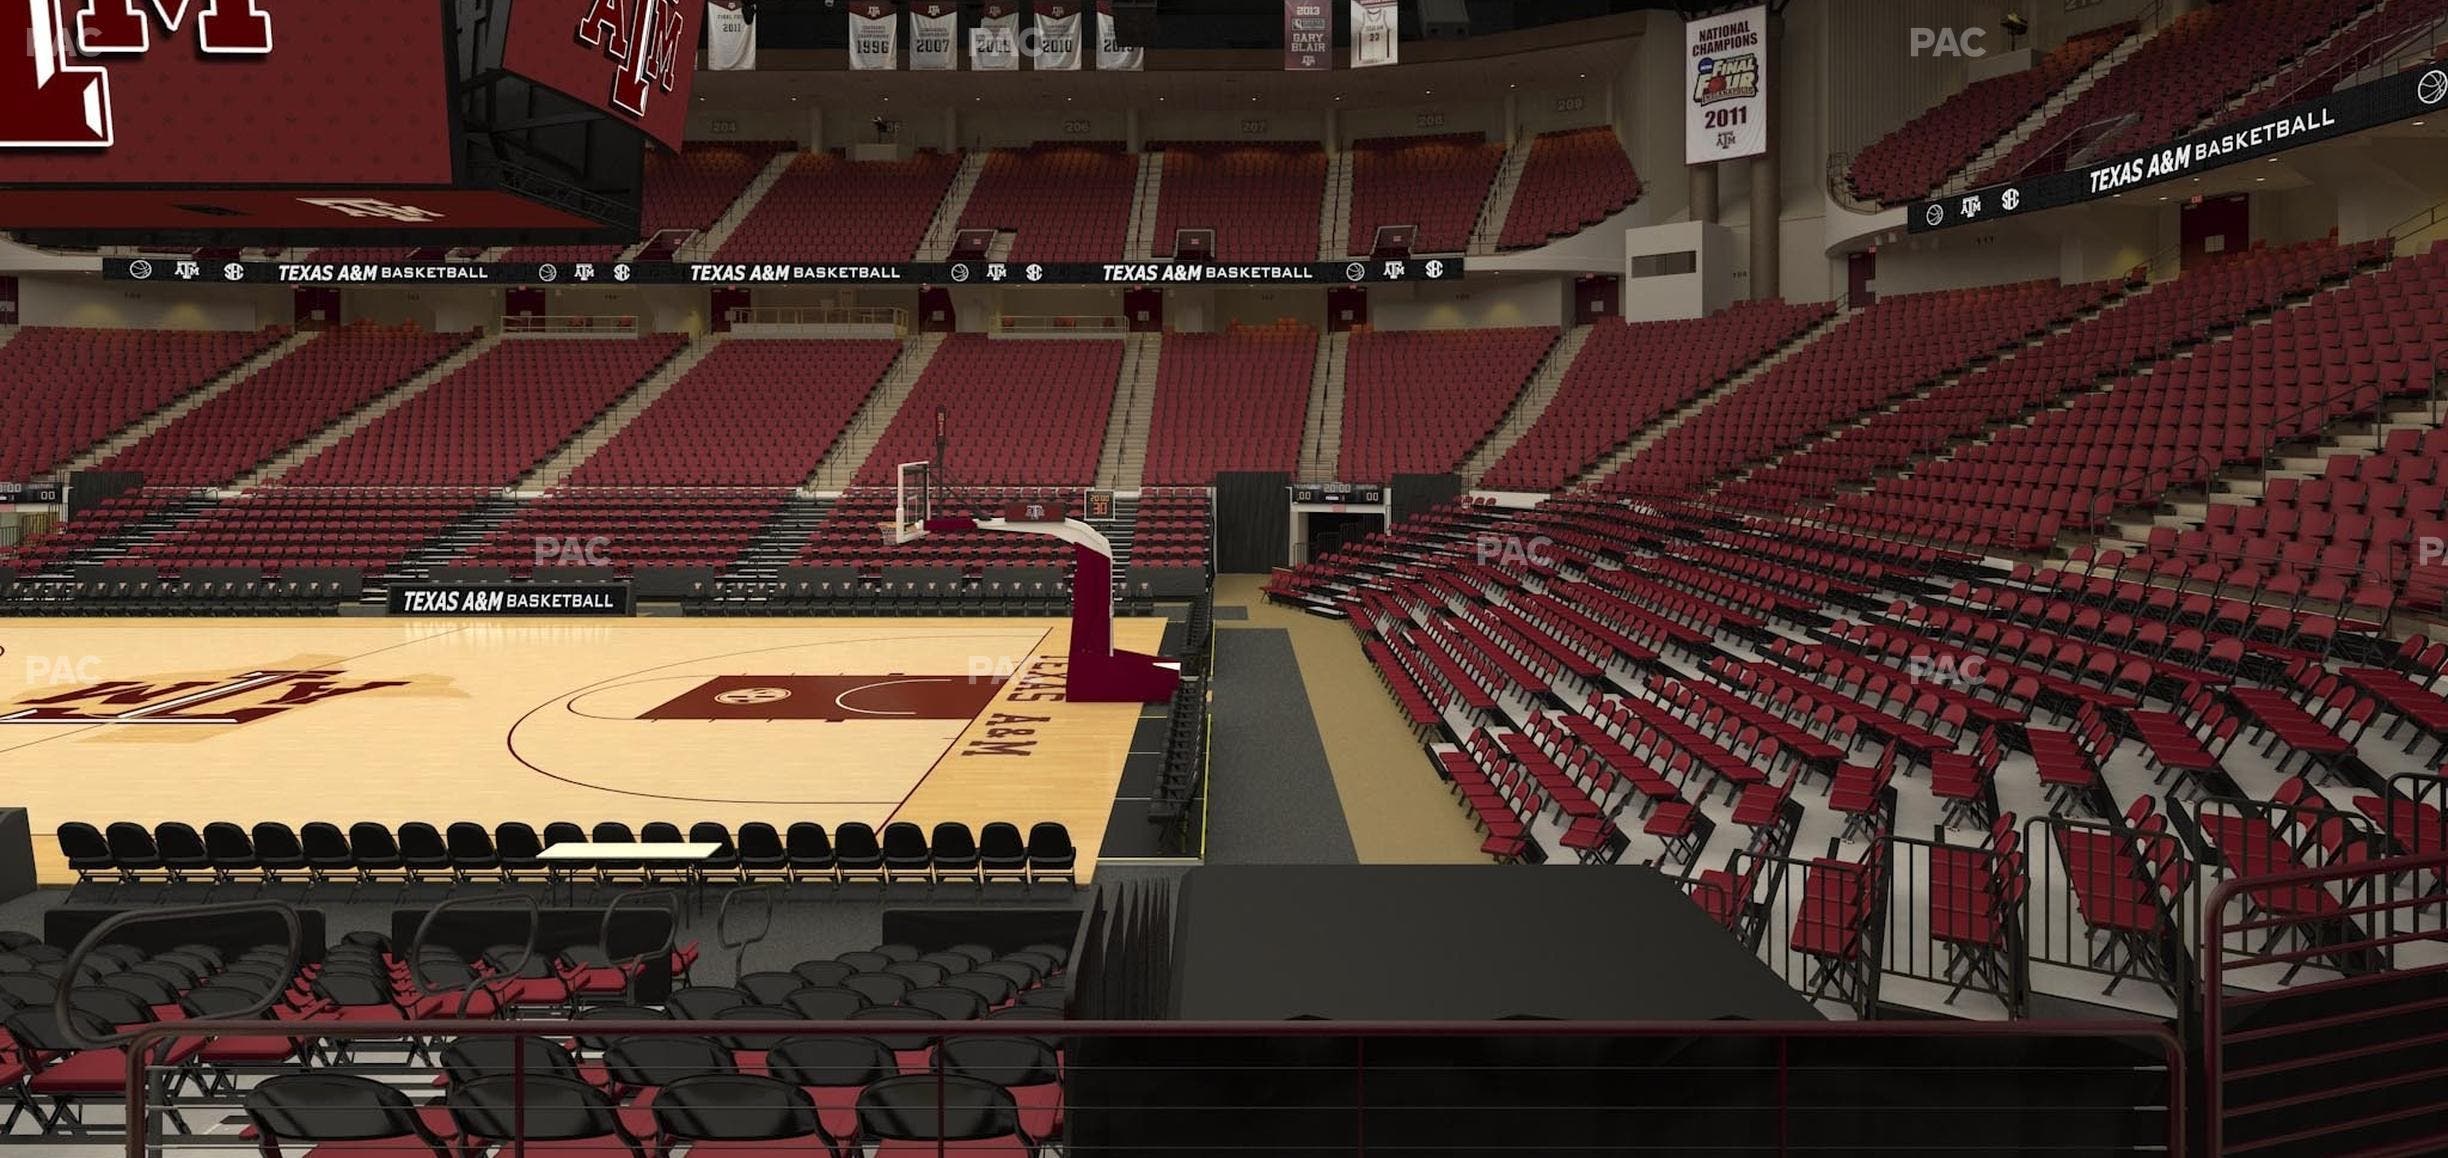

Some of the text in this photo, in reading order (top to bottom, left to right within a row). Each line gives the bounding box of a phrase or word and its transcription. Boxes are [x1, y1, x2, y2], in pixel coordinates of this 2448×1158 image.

[1296, 6, 1320, 16] 2013
[1293, 33, 1324, 43] GARY
[1699, 20, 1750, 42] NATIONAL
[857, 39, 890, 54] 1996
[916, 38, 949, 53] 2007
[1042, 39, 1073, 53] 2010
[1291, 42, 1326, 53] BLAIR
[1692, 32, 1758, 57] CHAMPIONS
[1713, 58, 1755, 77] FINAL
[1705, 105, 1747, 129] 2011
[2090, 108, 2336, 193] TEXAS A&M BASKETBALL
[277, 264, 489, 281] TEXAS A&M BASKETBALL
[690, 264, 901, 281] TEXAS A&M BASKETBALL
[1102, 264, 1313, 281] TEXAS A&M BASKETBALL
[41, 491, 56, 500] 00
[1299, 491, 1312, 501] 00
[1366, 492, 1379, 502] 00
[1092, 503, 1108, 516] 30
[402, 591, 614, 612] TEXAS A&M BASKETBALL
[961, 713, 1051, 756] A&M
